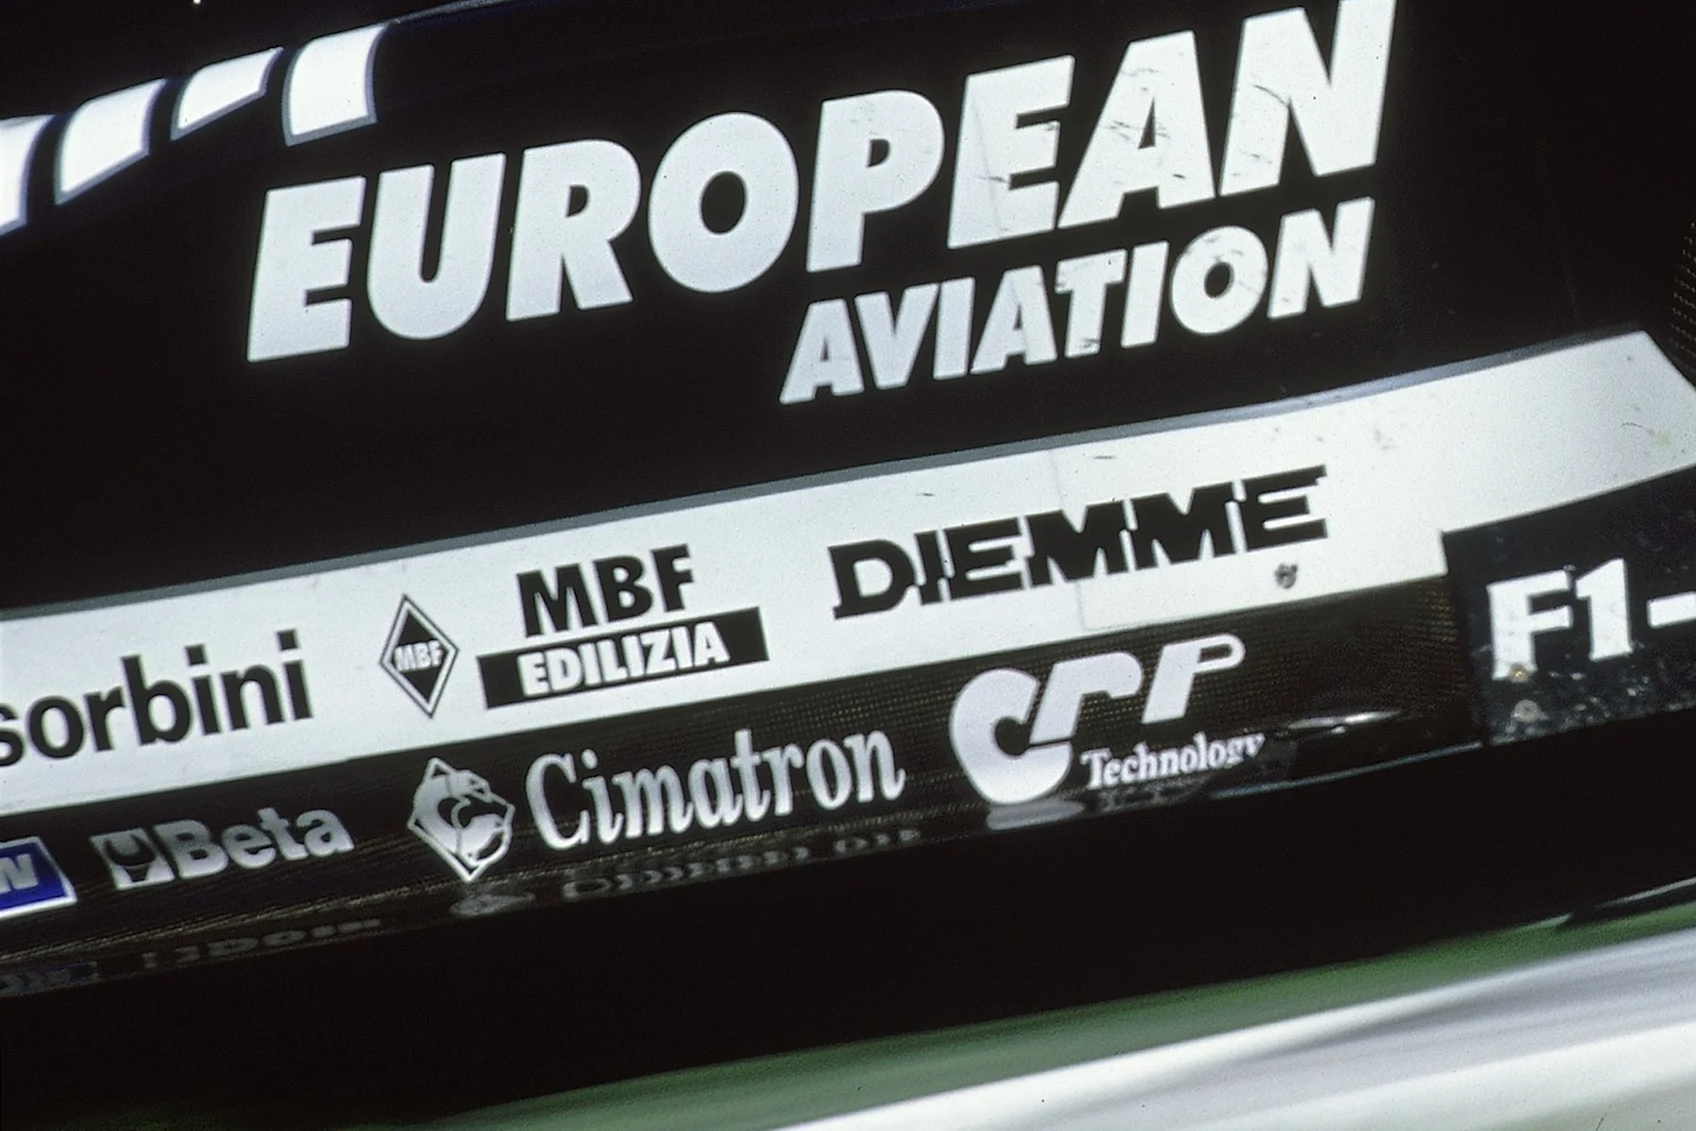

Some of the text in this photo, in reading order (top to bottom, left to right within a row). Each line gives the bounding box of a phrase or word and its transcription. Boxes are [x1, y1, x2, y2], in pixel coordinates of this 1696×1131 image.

[779, 197, 1375, 404] AVIATION
[827, 464, 1329, 620] DIEMME
[516, 544, 695, 639] MBF
[394, 639, 444, 672] MBF
[516, 622, 731, 699] EDILIZIA
[524, 728, 905, 850] Cimatron
[1080, 731, 1265, 791] Technology
[153, 806, 355, 880] Beta
